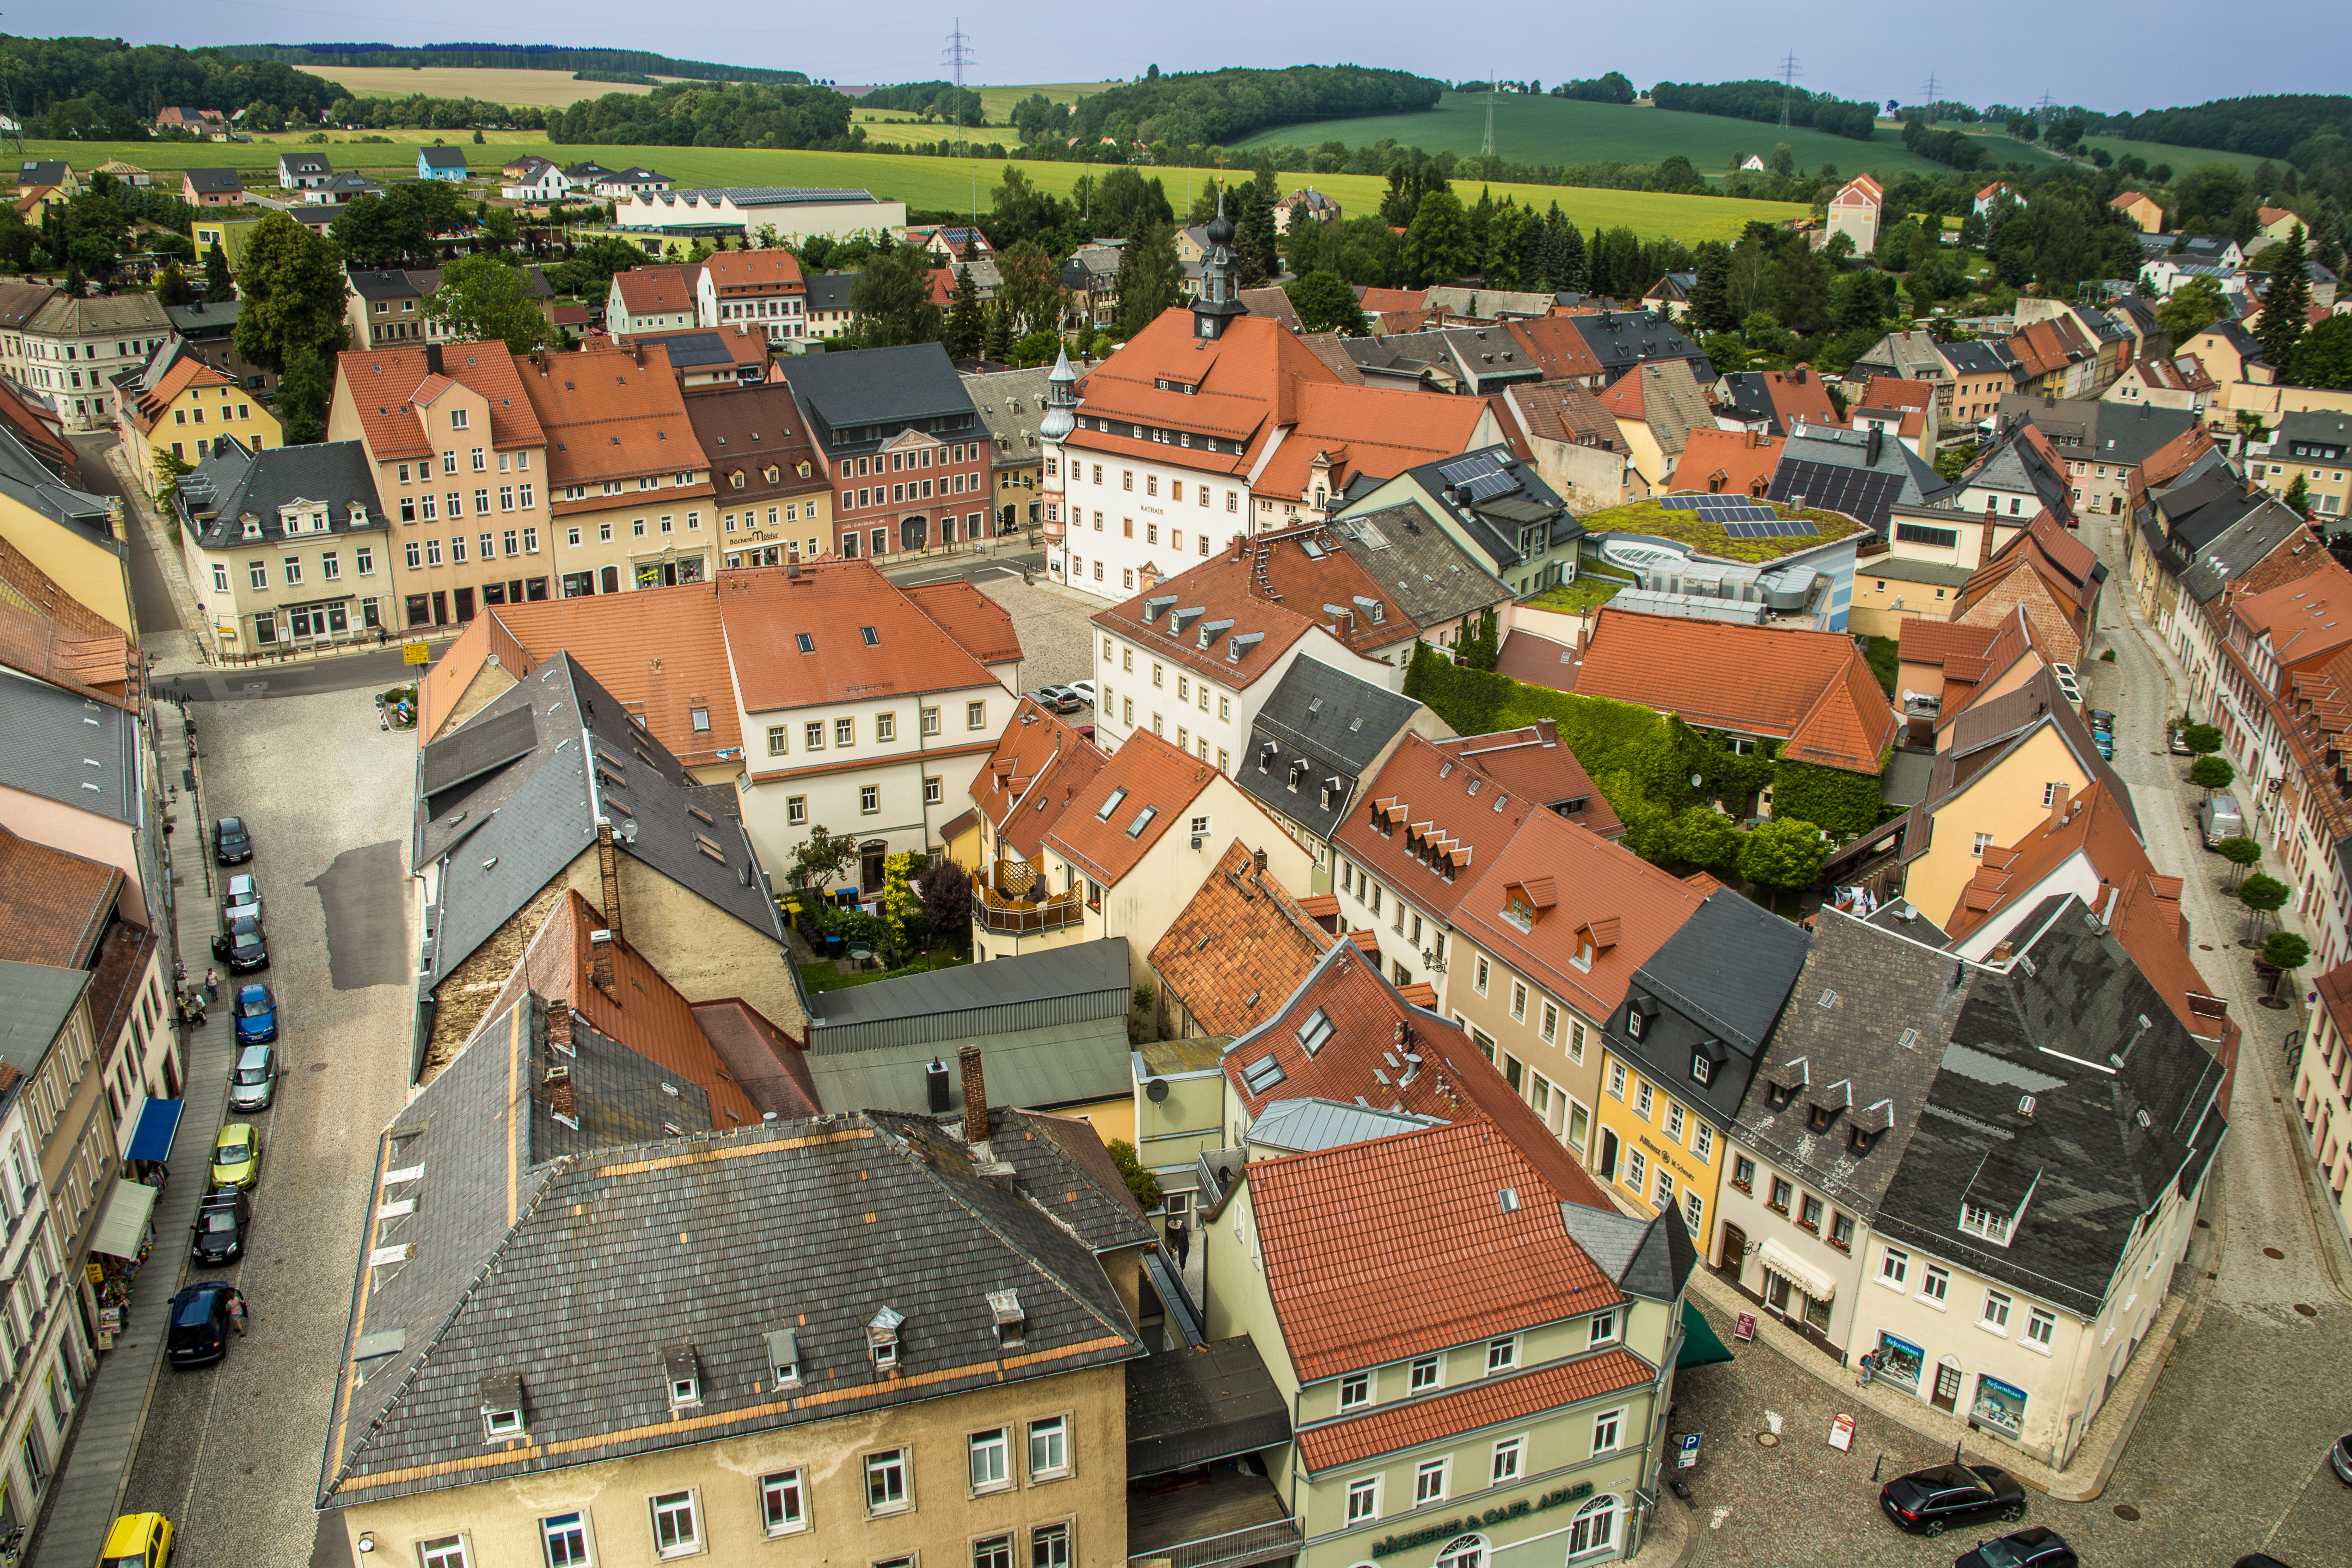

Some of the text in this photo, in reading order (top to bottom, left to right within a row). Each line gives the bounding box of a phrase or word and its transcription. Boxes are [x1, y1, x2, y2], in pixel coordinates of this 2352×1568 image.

[1141, 505, 1164, 515] RATHAUS
[730, 537, 754, 545] Bäckerei
[1639, 1134, 1661, 1156] Allianz
[1768, 1256, 1803, 1282] Goldschmiede
[1887, 1337, 1919, 1356] Reformhaus
[1987, 1378, 2021, 1400] Reformhaus
[1685, 1436, 1697, 1449] P
[1372, 1519, 1462, 1557] BÄCKEREI
[1465, 1515, 1481, 1529] &
[1537, 1481, 1594, 1510] ADLER
